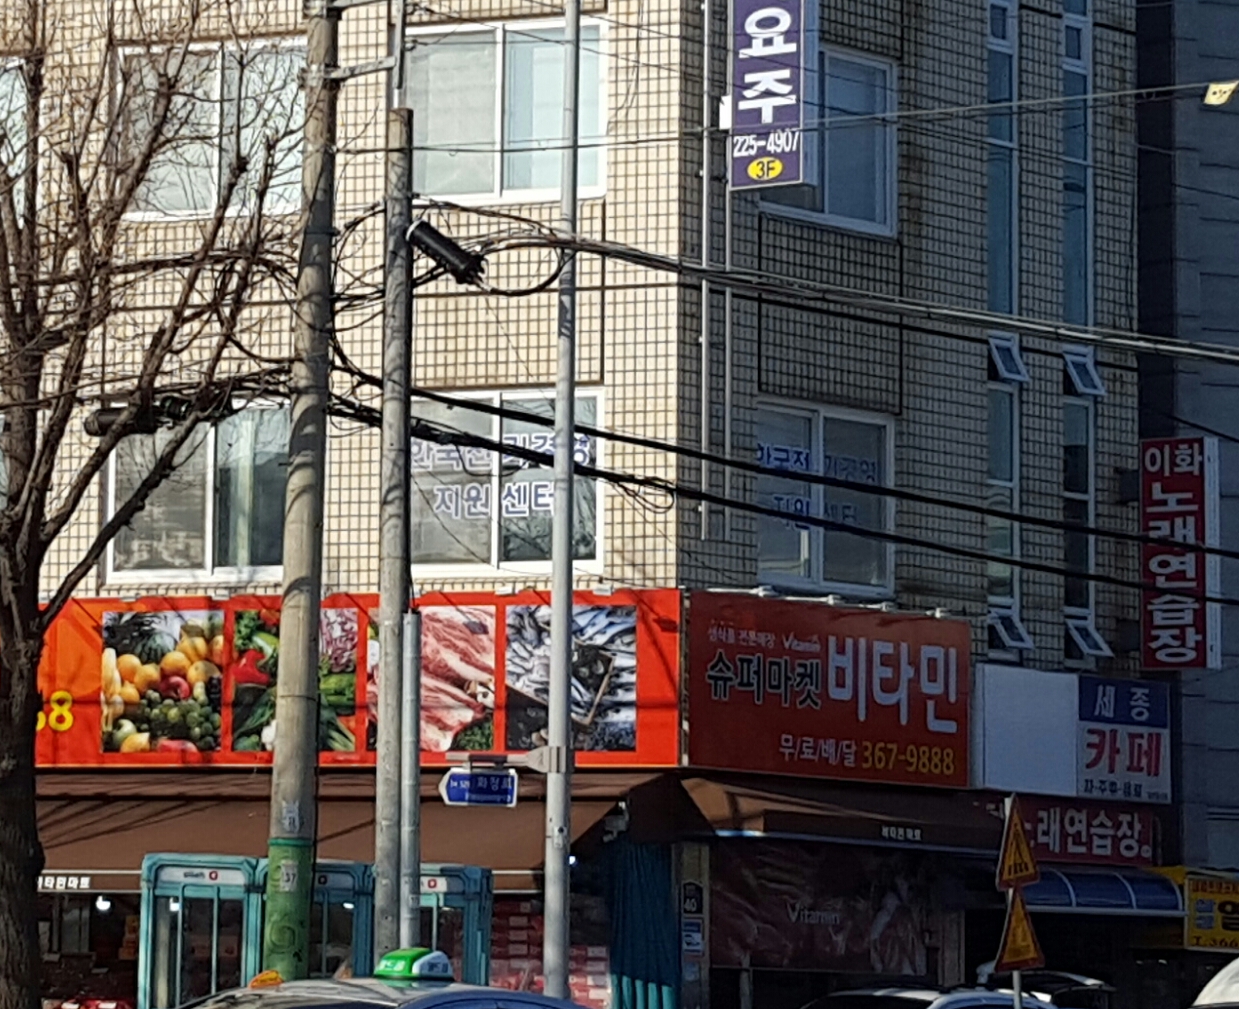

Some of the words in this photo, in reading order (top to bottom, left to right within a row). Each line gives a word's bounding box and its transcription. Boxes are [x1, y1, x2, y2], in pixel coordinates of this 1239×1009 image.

[732, 127, 800, 159] 225-4907
[755, 159, 776, 179] 3F
[1144, 442, 1203, 477] 이화
[433, 481, 554, 520] 지원센터
[1145, 481, 1204, 664] 노래연습장
[705, 648, 823, 710] 슈퍼마켓
[828, 635, 958, 734] 비타민
[1093, 683, 1151, 722] 세종
[779, 733, 858, 768] 무/료/배/달
[861, 741, 956, 776] 367-9888
[1085, 728, 1162, 777] 카페
[1023, 806, 1142, 859] 래연습장
